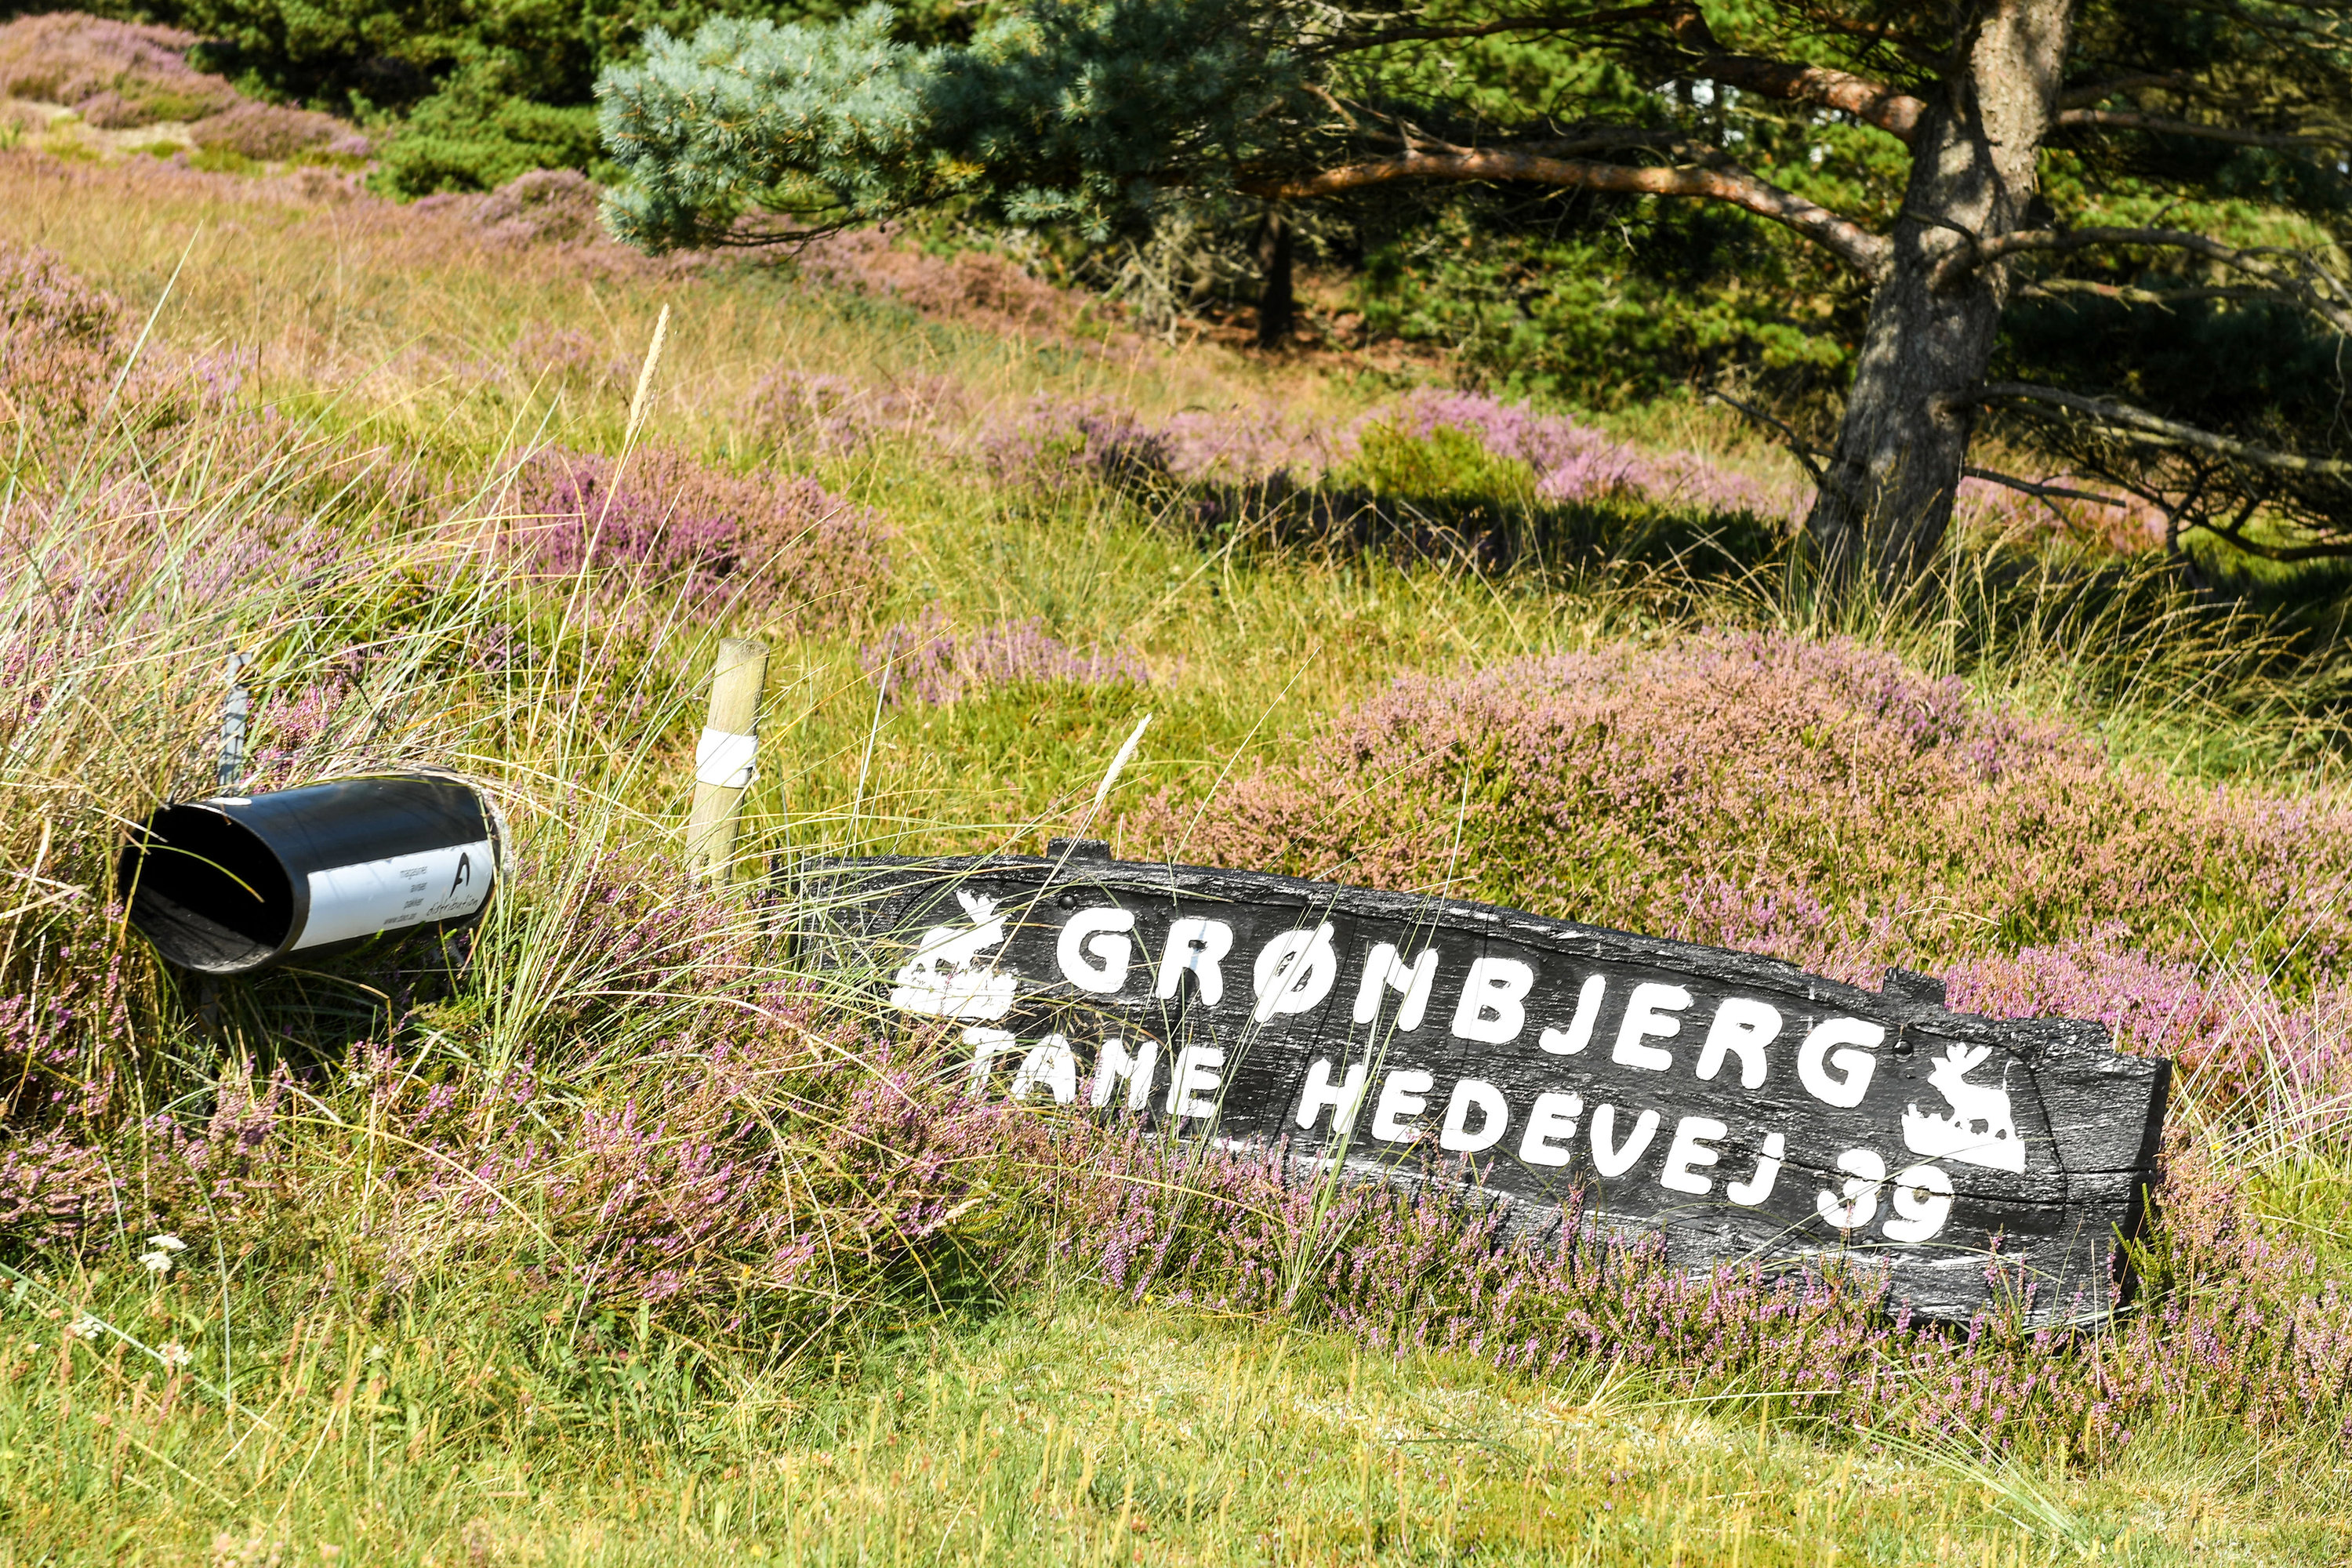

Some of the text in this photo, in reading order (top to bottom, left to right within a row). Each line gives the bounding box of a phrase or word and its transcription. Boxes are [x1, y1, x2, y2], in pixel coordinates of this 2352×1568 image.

[426, 895, 478, 916] distribution
[1056, 906, 1886, 1108] GRØNBJERG
[962, 1027, 1954, 1243] TAME HEDEVEJ 39
